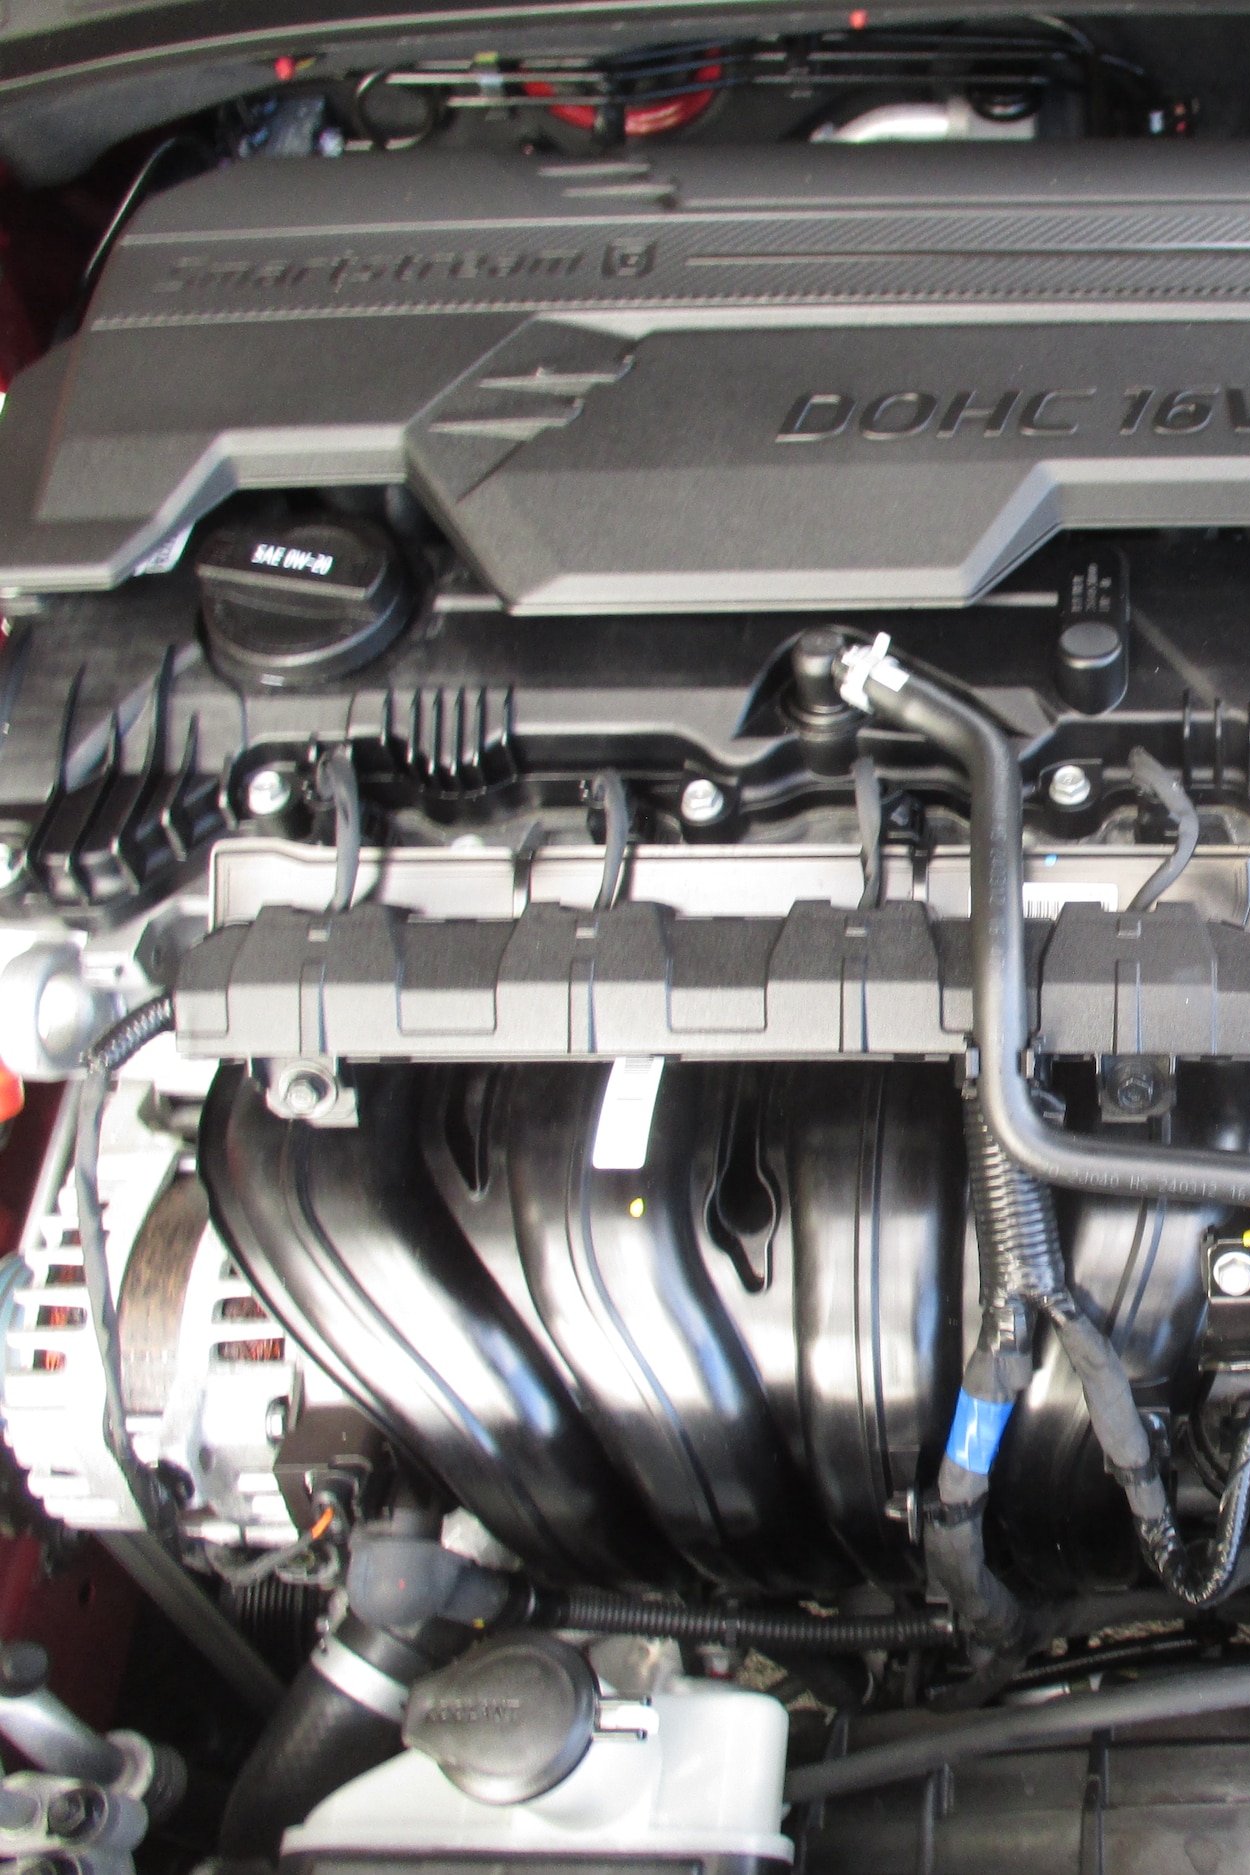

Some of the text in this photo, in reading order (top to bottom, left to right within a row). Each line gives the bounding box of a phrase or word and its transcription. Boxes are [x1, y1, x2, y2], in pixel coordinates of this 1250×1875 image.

[151, 247, 585, 294] Smartstream
[775, 386, 1098, 443] DOHC
[251, 543, 335, 576] SAE 0W-20
